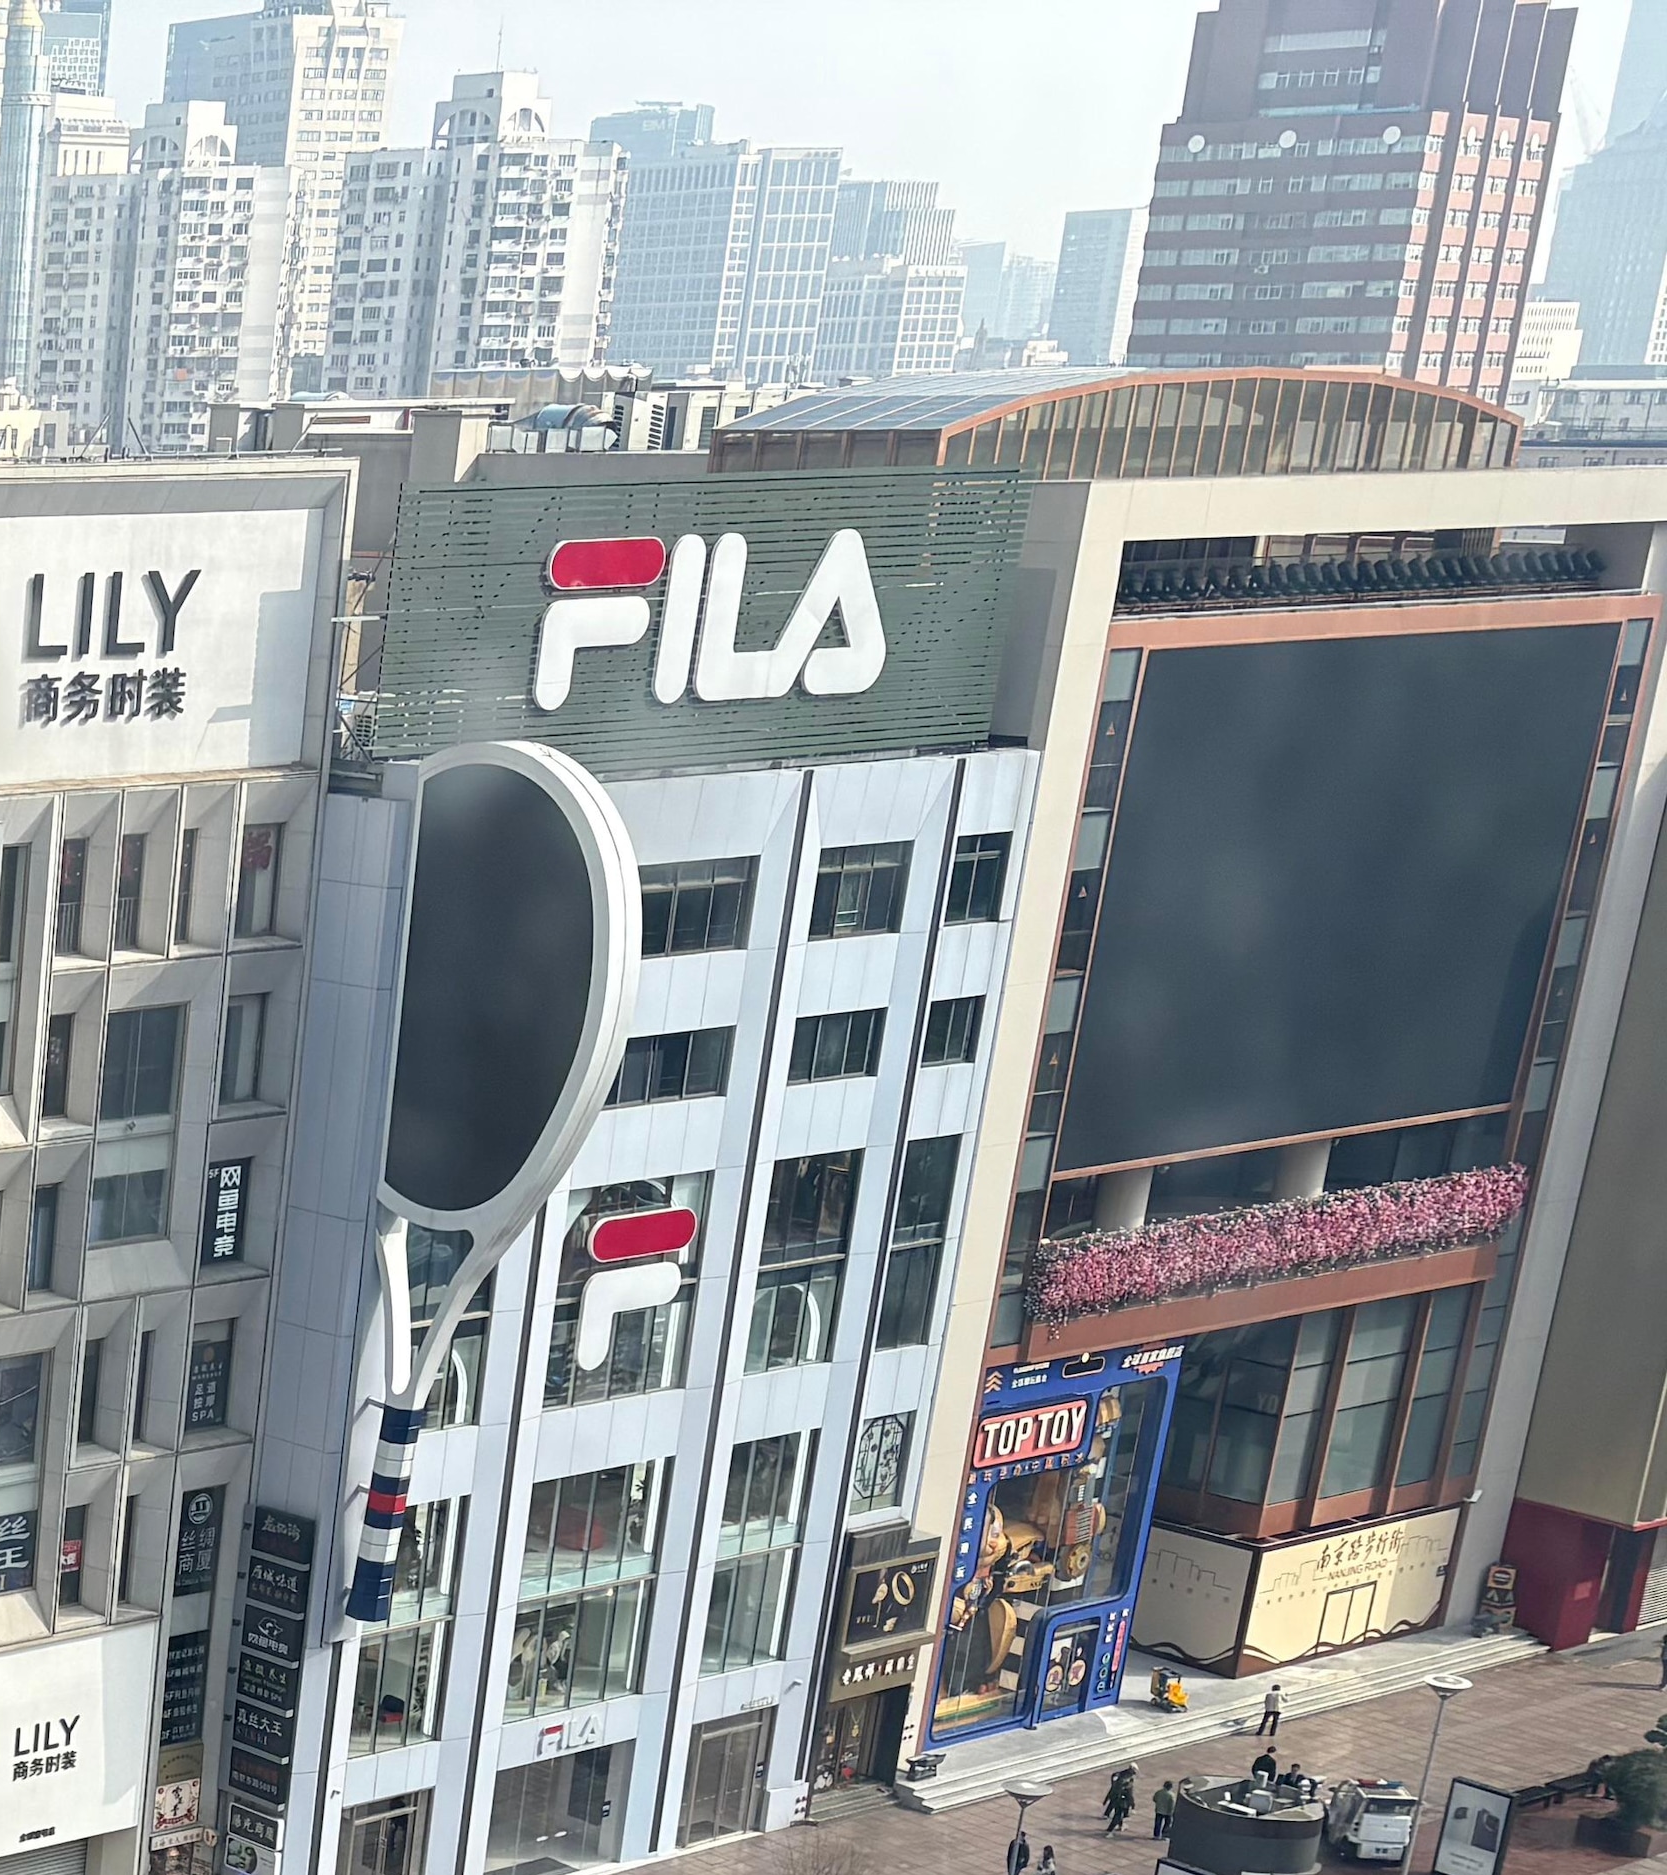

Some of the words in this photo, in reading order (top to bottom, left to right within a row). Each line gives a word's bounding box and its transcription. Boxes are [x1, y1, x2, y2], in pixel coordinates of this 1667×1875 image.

[25, 569, 201, 661] LILY
[533, 527, 887, 712] FILA
[18, 667, 186, 728] 商务时装
[213, 1165, 241, 1258] 网鱼电竞
[191, 1409, 214, 1421] SPA
[983, 1416, 1034, 1459] TOP
[1037, 1405, 1087, 1449] TOY
[180, 1527, 215, 1551] 丝绸
[178, 1549, 212, 1575] 商厦
[13, 1714, 80, 1757] LILY
[237, 1707, 282, 1737] 真丝大王
[536, 1715, 603, 1755] FILA
[12, 1751, 78, 1782] 商务时装
